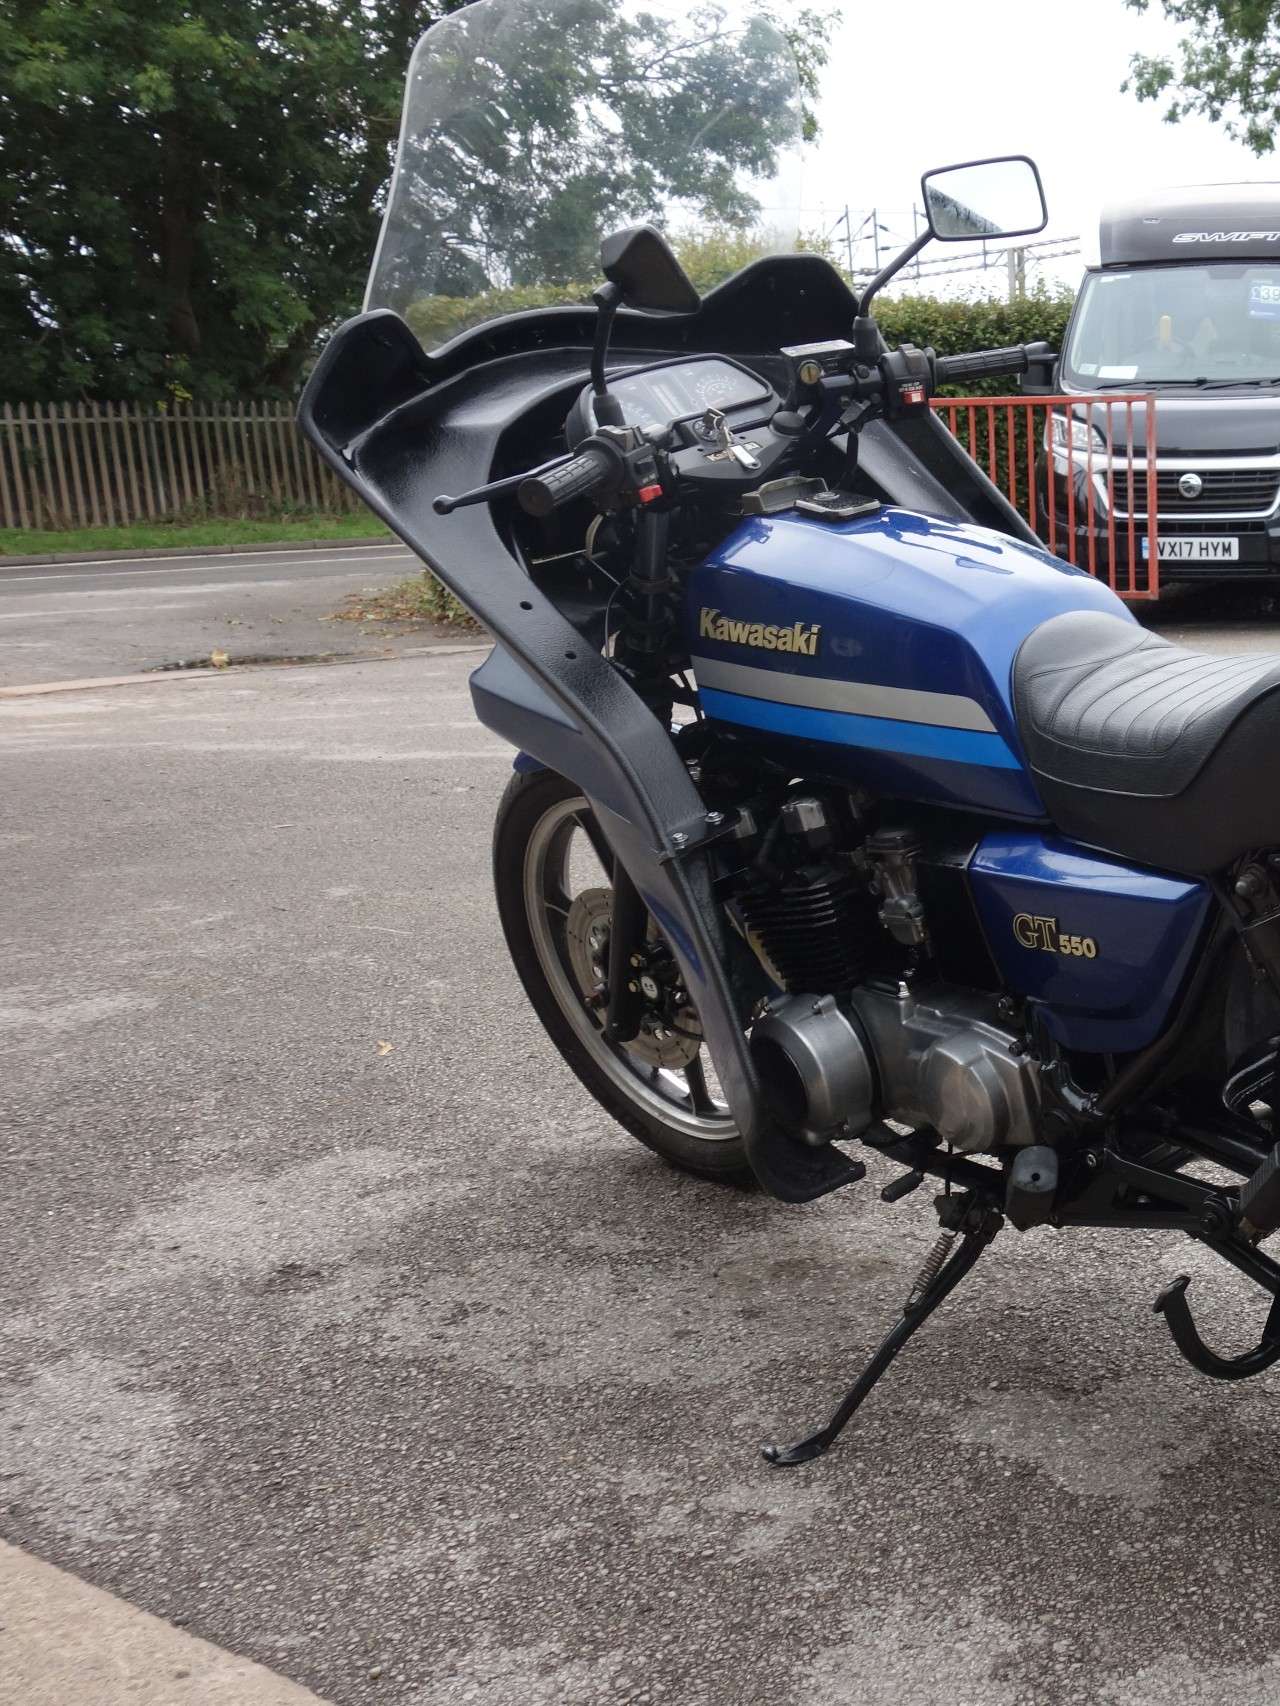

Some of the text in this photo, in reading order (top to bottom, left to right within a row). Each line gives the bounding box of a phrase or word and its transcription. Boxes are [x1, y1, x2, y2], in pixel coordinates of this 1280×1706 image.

[1157, 541, 1232, 557] VX17 HYM
[700, 607, 822, 655] Kawasaki
[1013, 913, 1097, 958] GT 550
